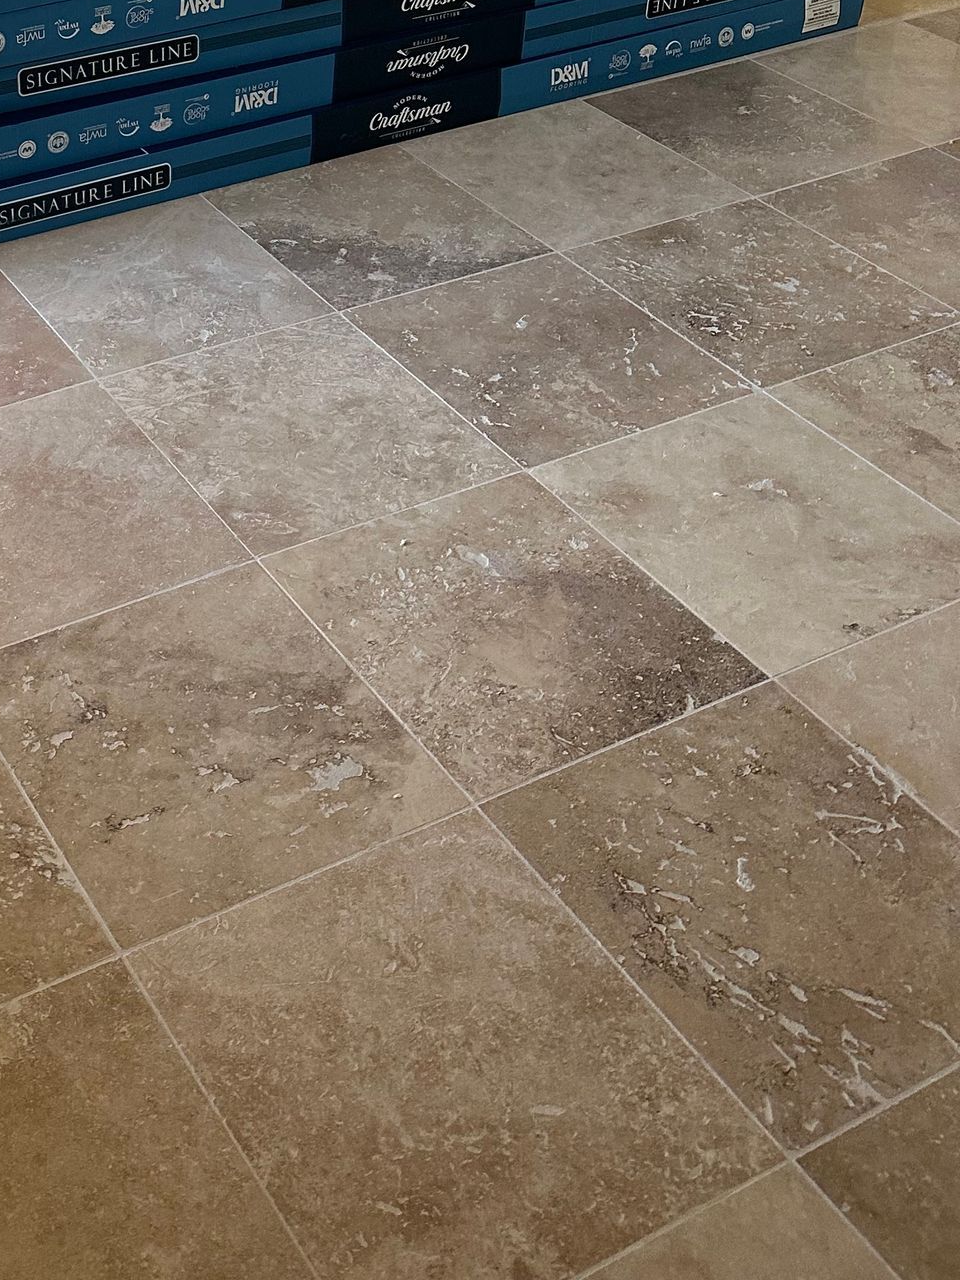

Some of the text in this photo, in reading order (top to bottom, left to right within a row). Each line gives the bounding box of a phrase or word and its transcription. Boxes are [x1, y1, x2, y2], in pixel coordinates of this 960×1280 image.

[16, 28, 46, 46] nwfa
[690, 33, 711, 50] nwfa
[26, 42, 193, 90] SIGNATURE LINE
[387, 44, 469, 73] Craftsman
[410, 64, 445, 79] MODERN
[551, 61, 588, 86] D&M
[235, 80, 279, 95] FLOORING
[550, 79, 588, 93] FLOORING
[235, 87, 278, 112] D&M
[393, 94, 427, 110] MODERN
[370, 101, 452, 131] Craftsman
[79, 127, 107, 145] nwfa
[0, 170, 165, 226] SIGNATURE LINE
